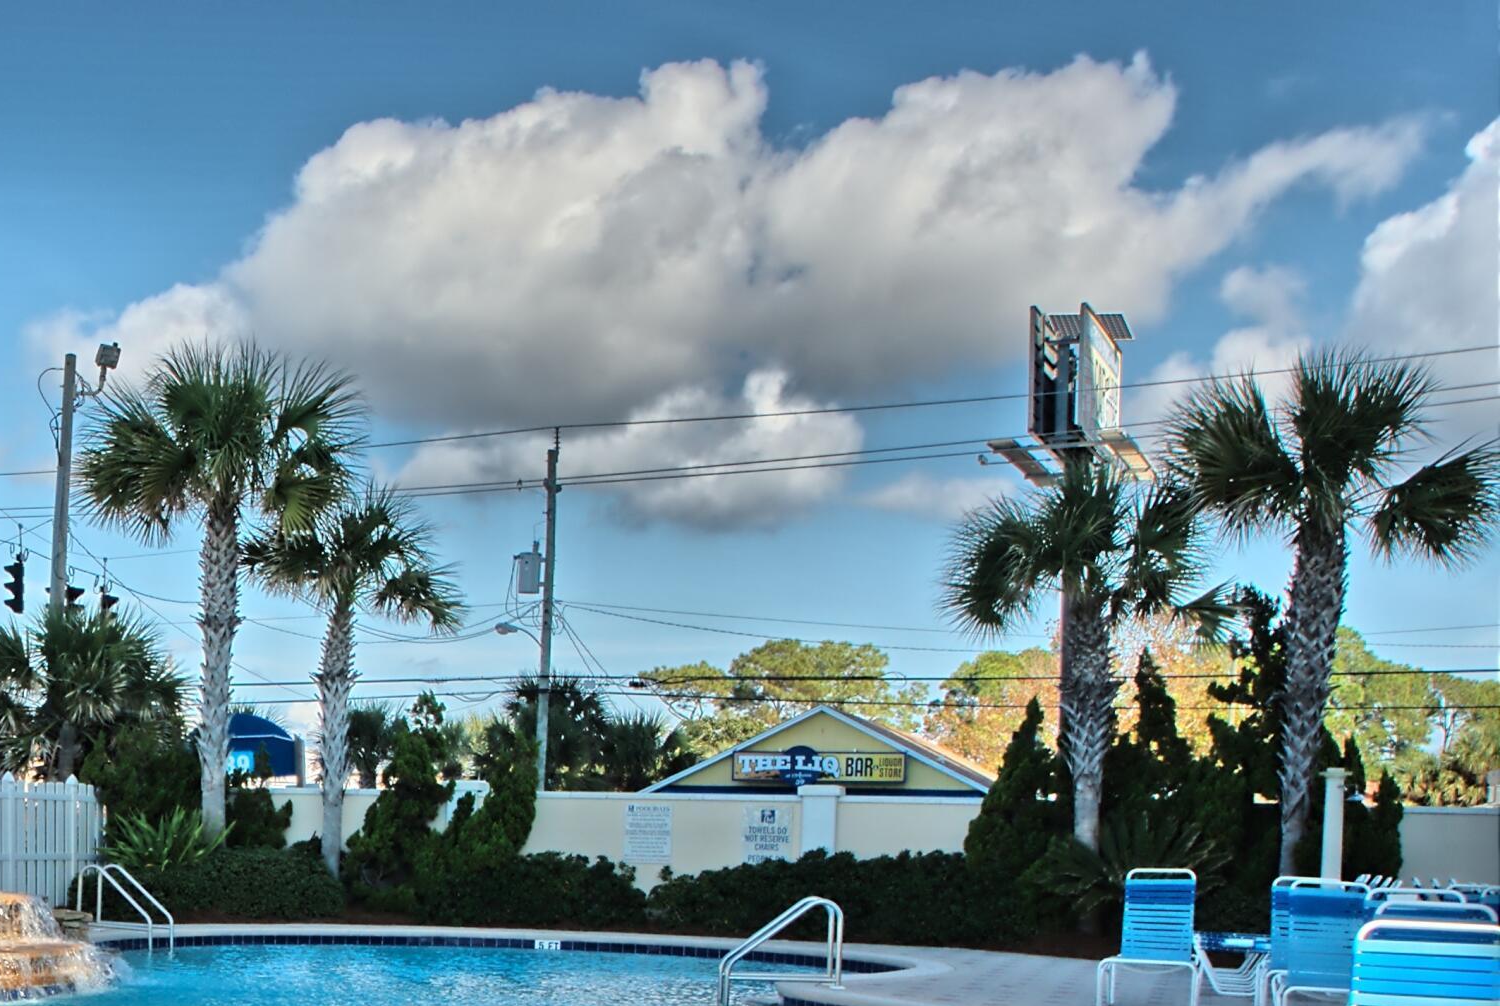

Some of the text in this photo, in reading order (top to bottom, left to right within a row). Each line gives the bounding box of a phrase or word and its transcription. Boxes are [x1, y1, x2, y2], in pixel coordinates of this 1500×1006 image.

[739, 755, 840, 778] THE LIQ
[879, 757, 903, 767] LIQUOR
[845, 757, 873, 777] BAR
[879, 767, 902, 778] STORE
[749, 826, 788, 835] TOWELS DO
[759, 834, 789, 843] RESERVE
[754, 843, 779, 851] CHAIRS
[748, 854, 773, 863] PEOP
